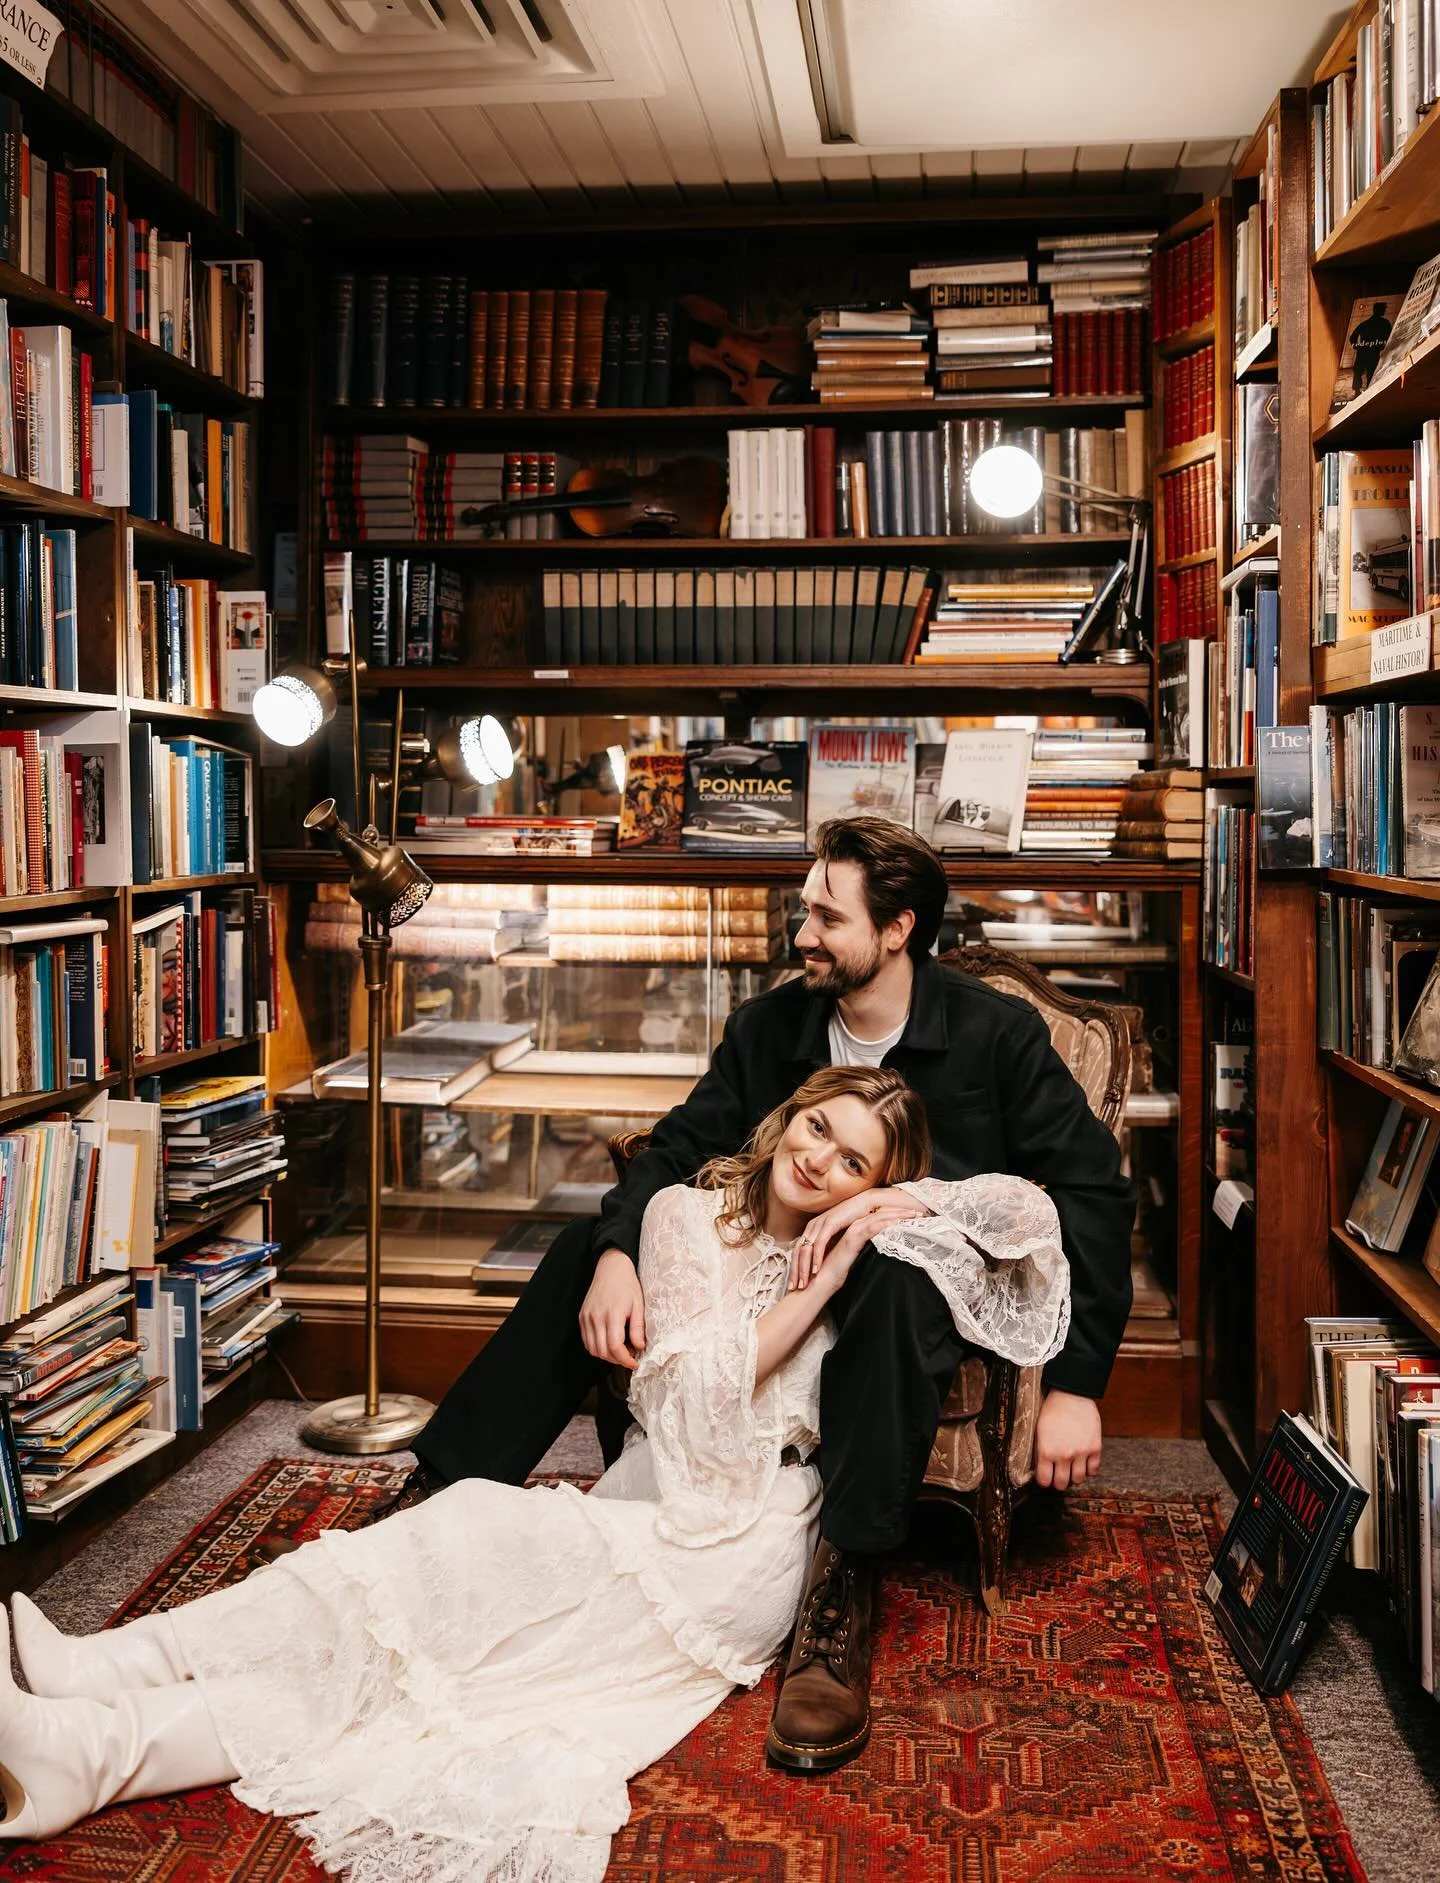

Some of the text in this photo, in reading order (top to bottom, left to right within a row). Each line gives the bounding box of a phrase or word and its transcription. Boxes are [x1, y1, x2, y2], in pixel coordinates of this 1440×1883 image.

[9, 47, 20, 63] OR
[21, 55, 36, 75] LESS
[15, 360, 26, 420] DELPHI
[419, 574, 429, 616] ENGLISH
[1378, 622, 1421, 648] MARITIME &
[1373, 648, 1425, 675] NAVAL HISTORY
[818, 730, 908, 762] MOUNT LOWE
[1266, 731, 1304, 748] The
[699, 778, 792, 794] PONTIAC
[699, 794, 793, 802] CONCEPT & SHOW CARS
[1264, 1447, 1326, 1532] TITANIC
